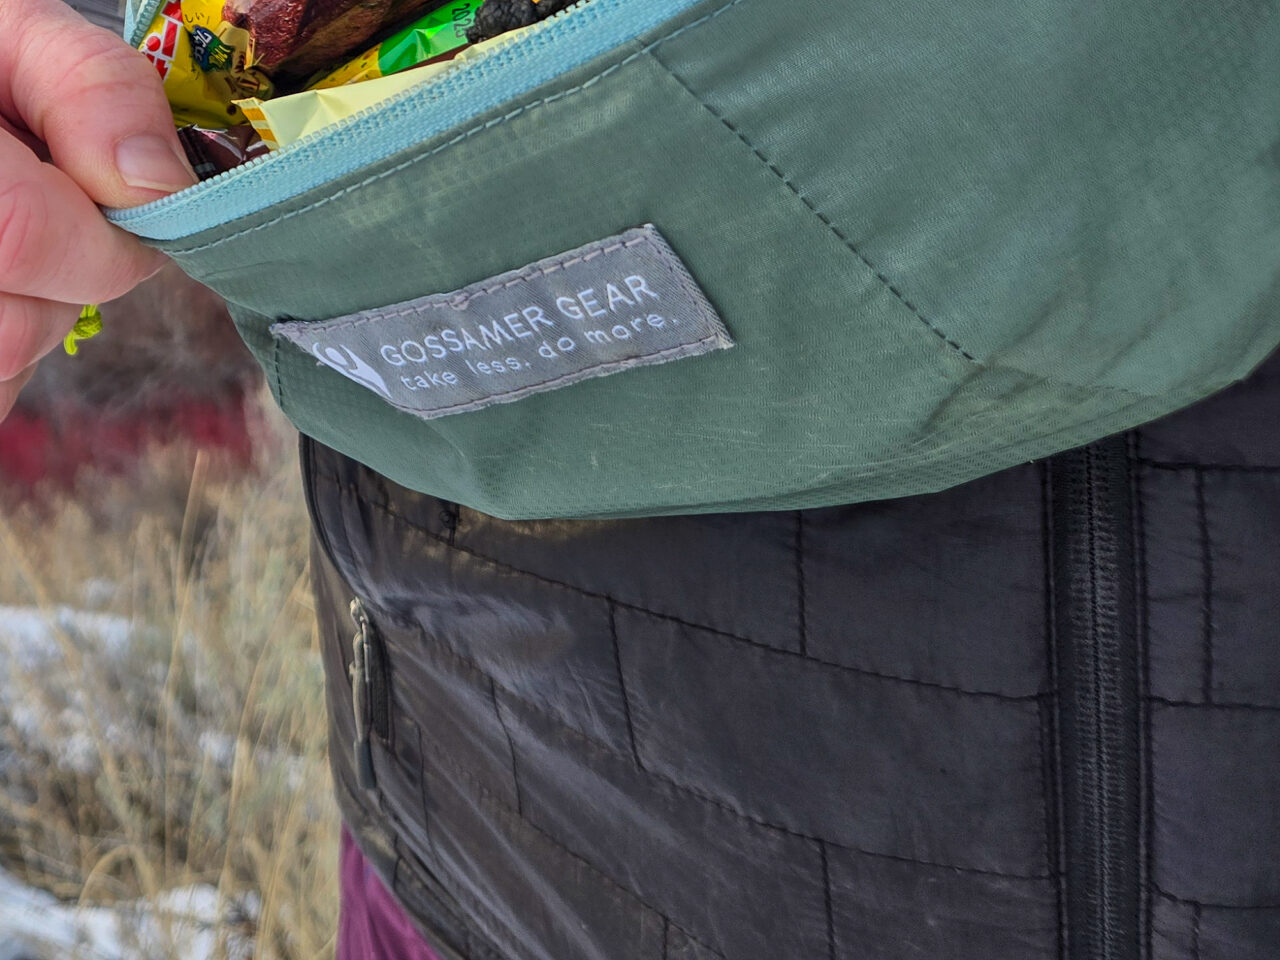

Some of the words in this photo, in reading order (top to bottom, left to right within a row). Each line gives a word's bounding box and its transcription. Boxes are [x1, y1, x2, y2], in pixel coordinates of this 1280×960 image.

[380, 305, 554, 368] GOSSAMER
[557, 274, 659, 321] GEAR
[401, 370, 458, 391] take
[538, 336, 574, 359] do
[583, 310, 679, 344] more.
